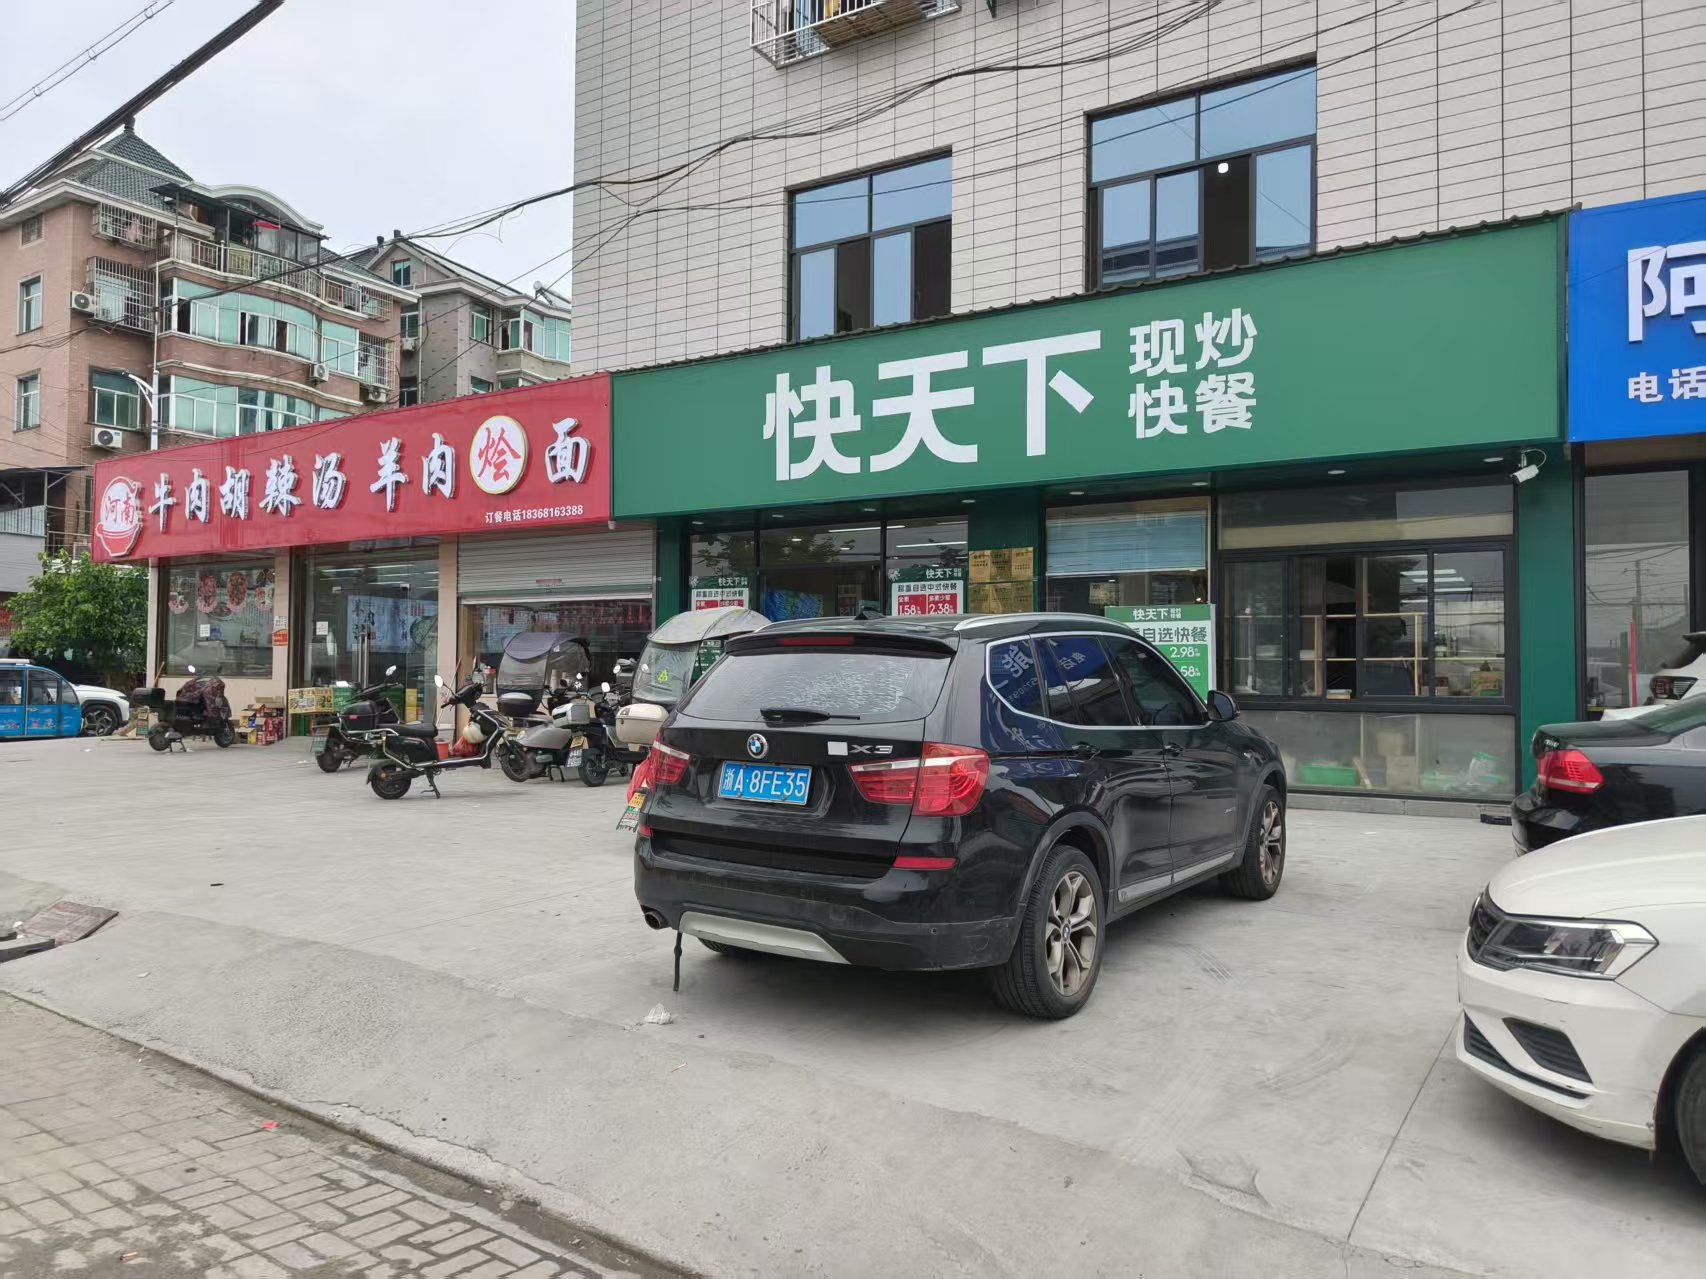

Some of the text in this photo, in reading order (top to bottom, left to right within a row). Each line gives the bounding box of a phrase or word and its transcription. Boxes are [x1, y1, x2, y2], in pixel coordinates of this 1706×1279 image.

[1129, 307, 1258, 377] 现炒
[1628, 365, 1706, 403] 电话
[763, 330, 1102, 481] 快天下
[1128, 372, 1257, 439] 快餐
[148, 452, 347, 533] 牛肉胡辣汤
[104, 495, 134, 525] 河南
[926, 568, 953, 579] 快天下
[1132, 608, 1168, 621] 快天下
[1169, 647, 1195, 658] 2.98
[850, 744, 894, 754] X3
